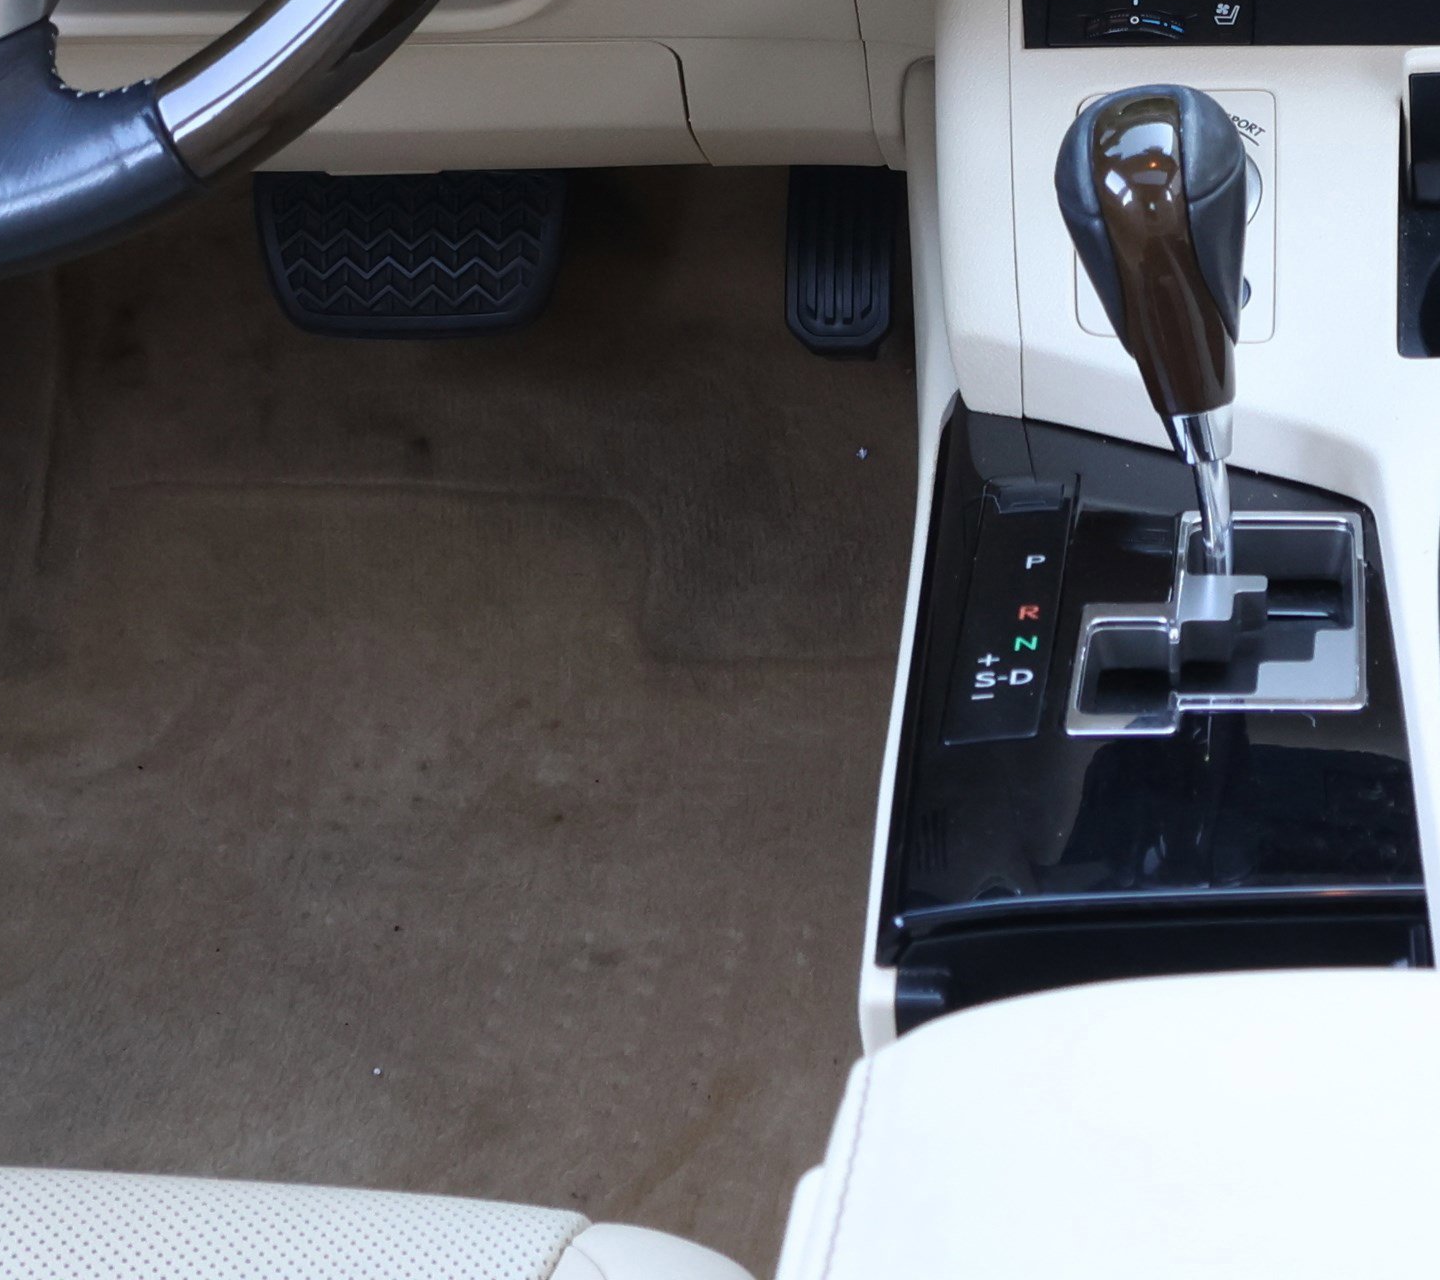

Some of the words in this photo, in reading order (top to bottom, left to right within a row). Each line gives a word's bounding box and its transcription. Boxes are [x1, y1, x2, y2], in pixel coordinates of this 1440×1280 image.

[1227, 113, 1266, 137] PORT
[1025, 554, 1046, 569] P
[1018, 605, 1040, 621] R
[1014, 635, 1038, 652] N
